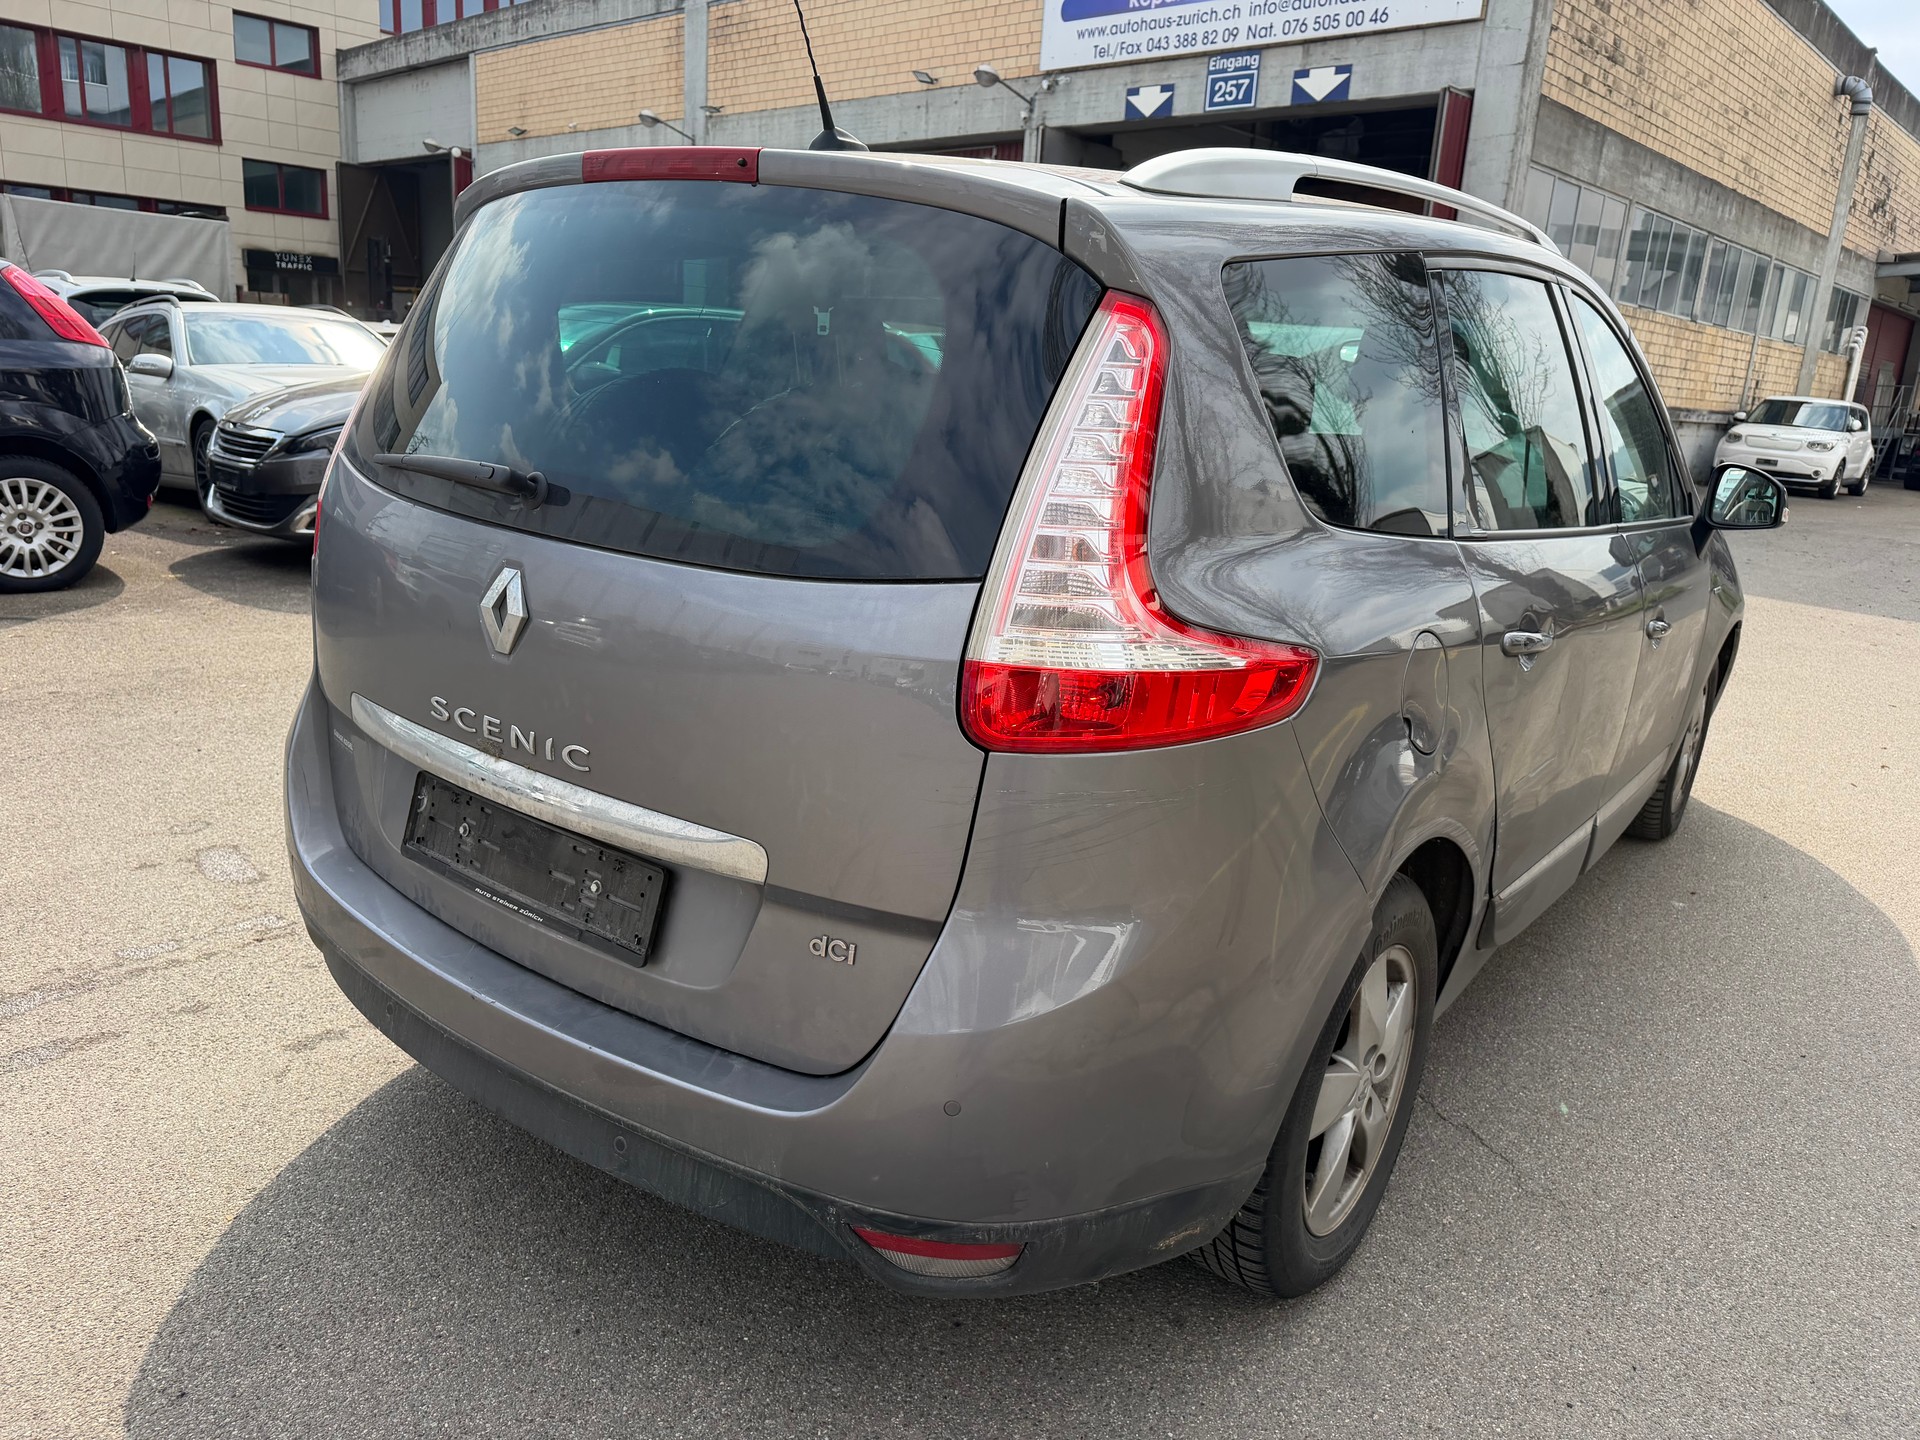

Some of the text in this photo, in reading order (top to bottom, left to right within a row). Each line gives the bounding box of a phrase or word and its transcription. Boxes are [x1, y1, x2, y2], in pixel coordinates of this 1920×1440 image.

[1076, 4, 1241, 40] www.autohaus-zurich.ch
[1093, 6, 1389, 60] Tel./Fax 043 388 82 09 Nat. 076 505 00 46
[1209, 54, 1260, 71] Eingang
[1212, 78, 1251, 103] 257
[275, 252, 312, 263] YUNEX
[276, 261, 313, 271] TRAFFIC
[430, 695, 591, 772] SCENIC
[474, 887, 492, 898] AUTO
